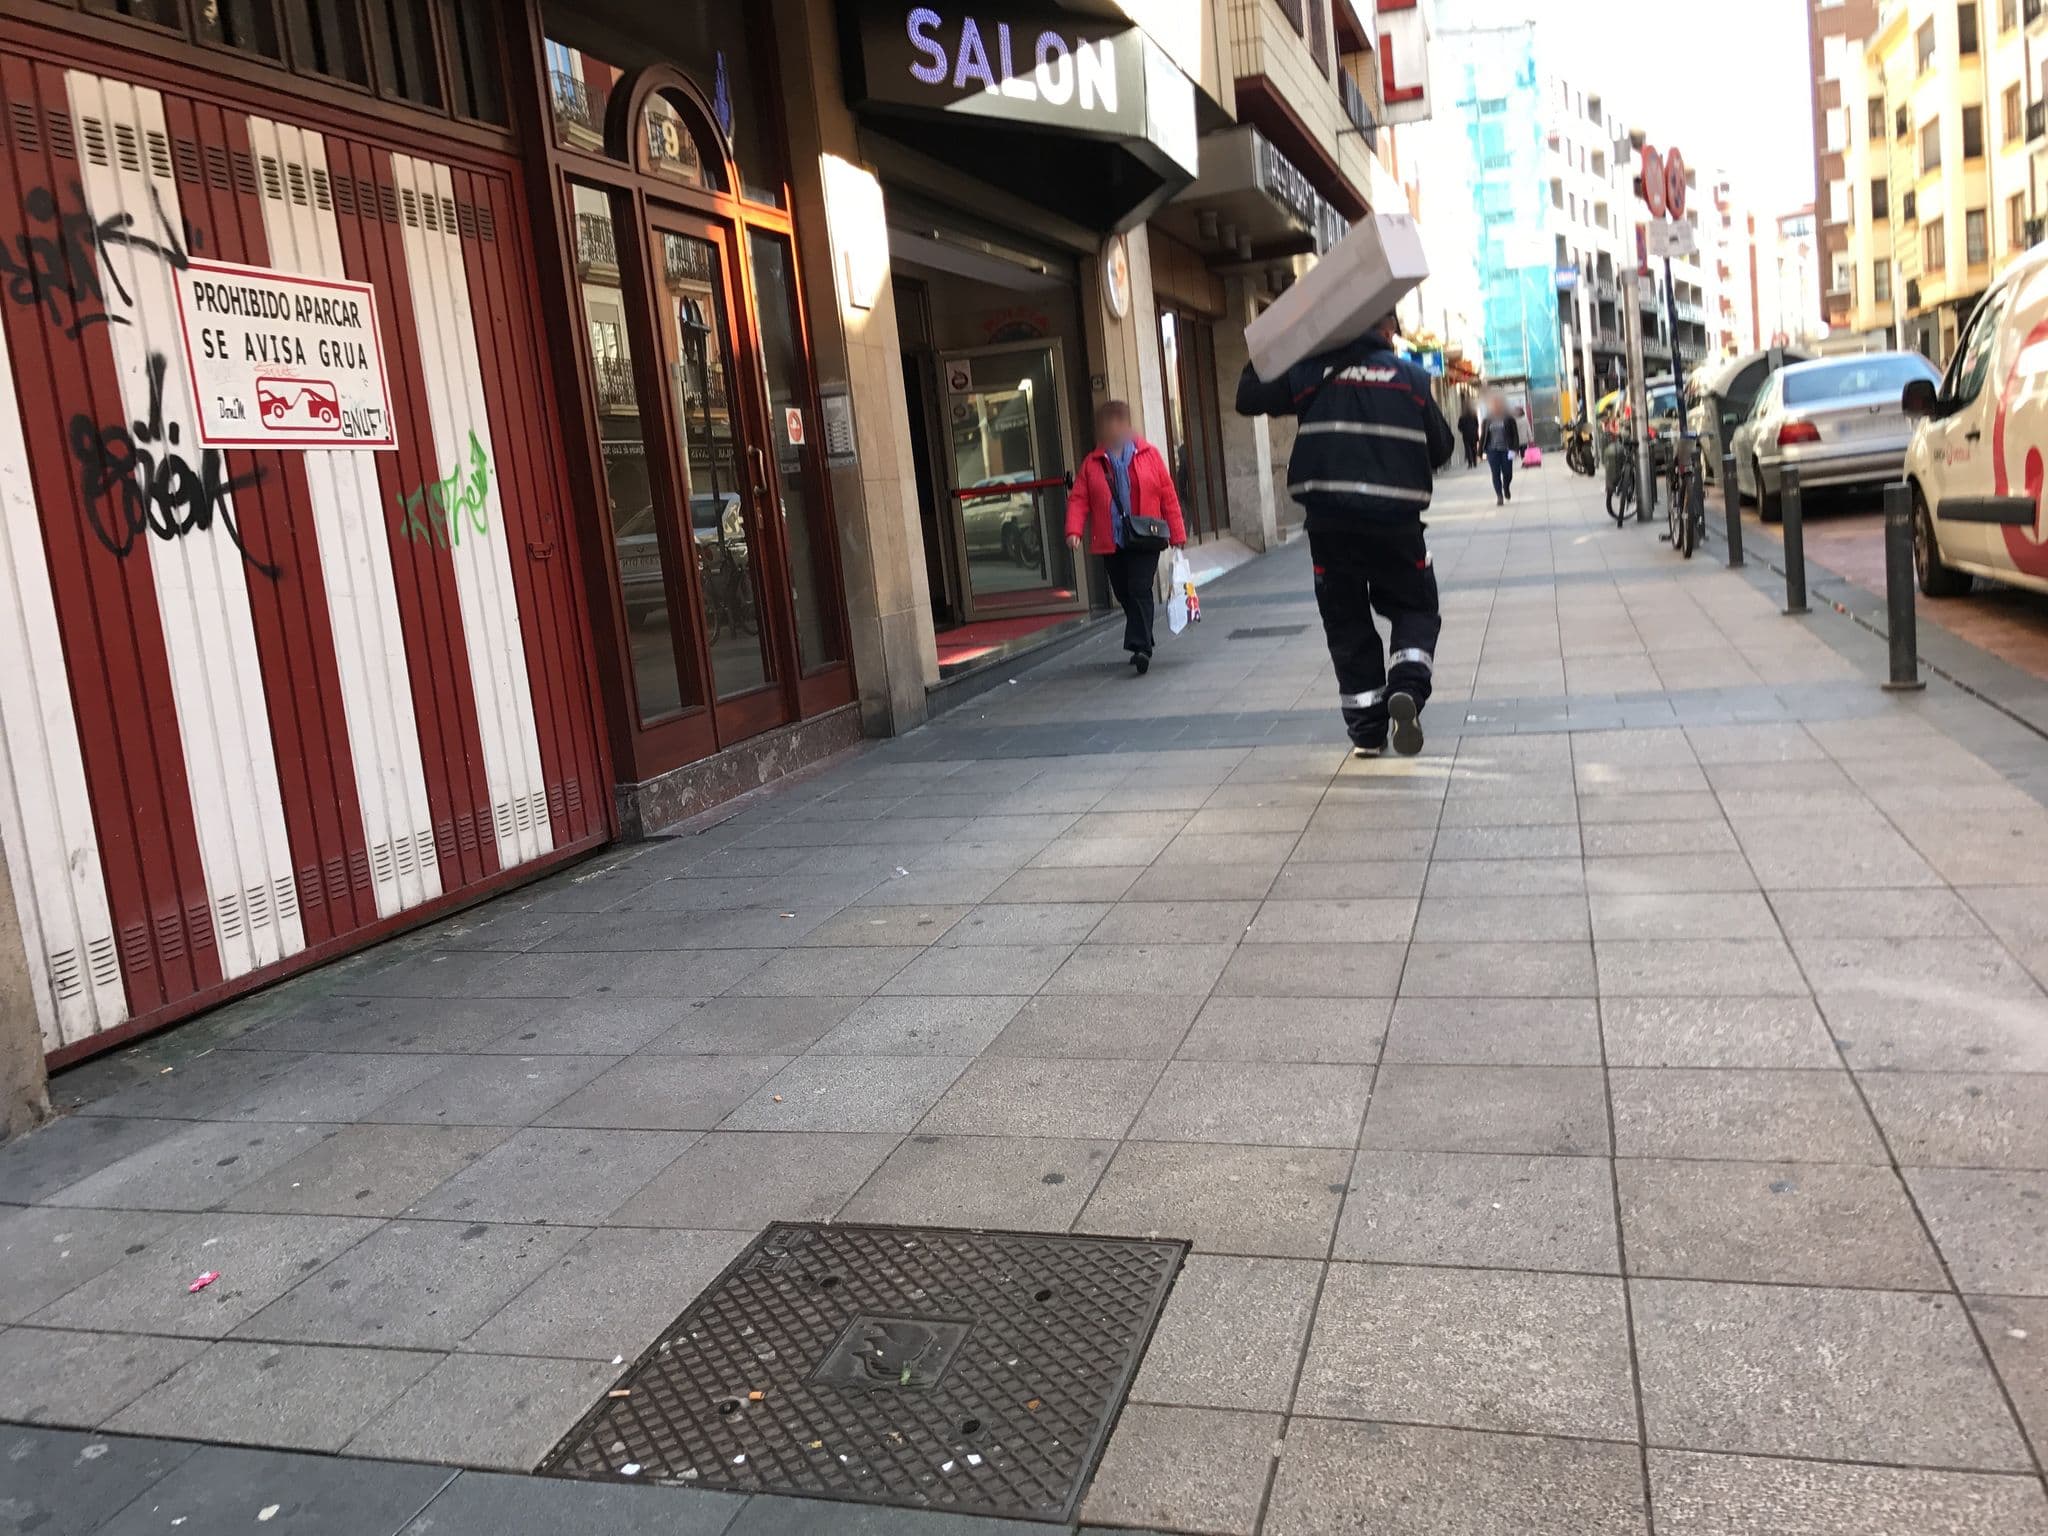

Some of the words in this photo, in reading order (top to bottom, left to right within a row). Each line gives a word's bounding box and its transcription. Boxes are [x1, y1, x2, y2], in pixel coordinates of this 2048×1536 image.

[906, 7, 1118, 113] SALON
[1376, 0, 1424, 105] L
[661, 120, 679, 158] 9
[193, 281, 290, 321] PROHIBIDO
[295, 295, 362, 328] APARCAR
[201, 327, 230, 360] SE
[244, 332, 307, 366] AVISA
[317, 338, 368, 370] GRUA
